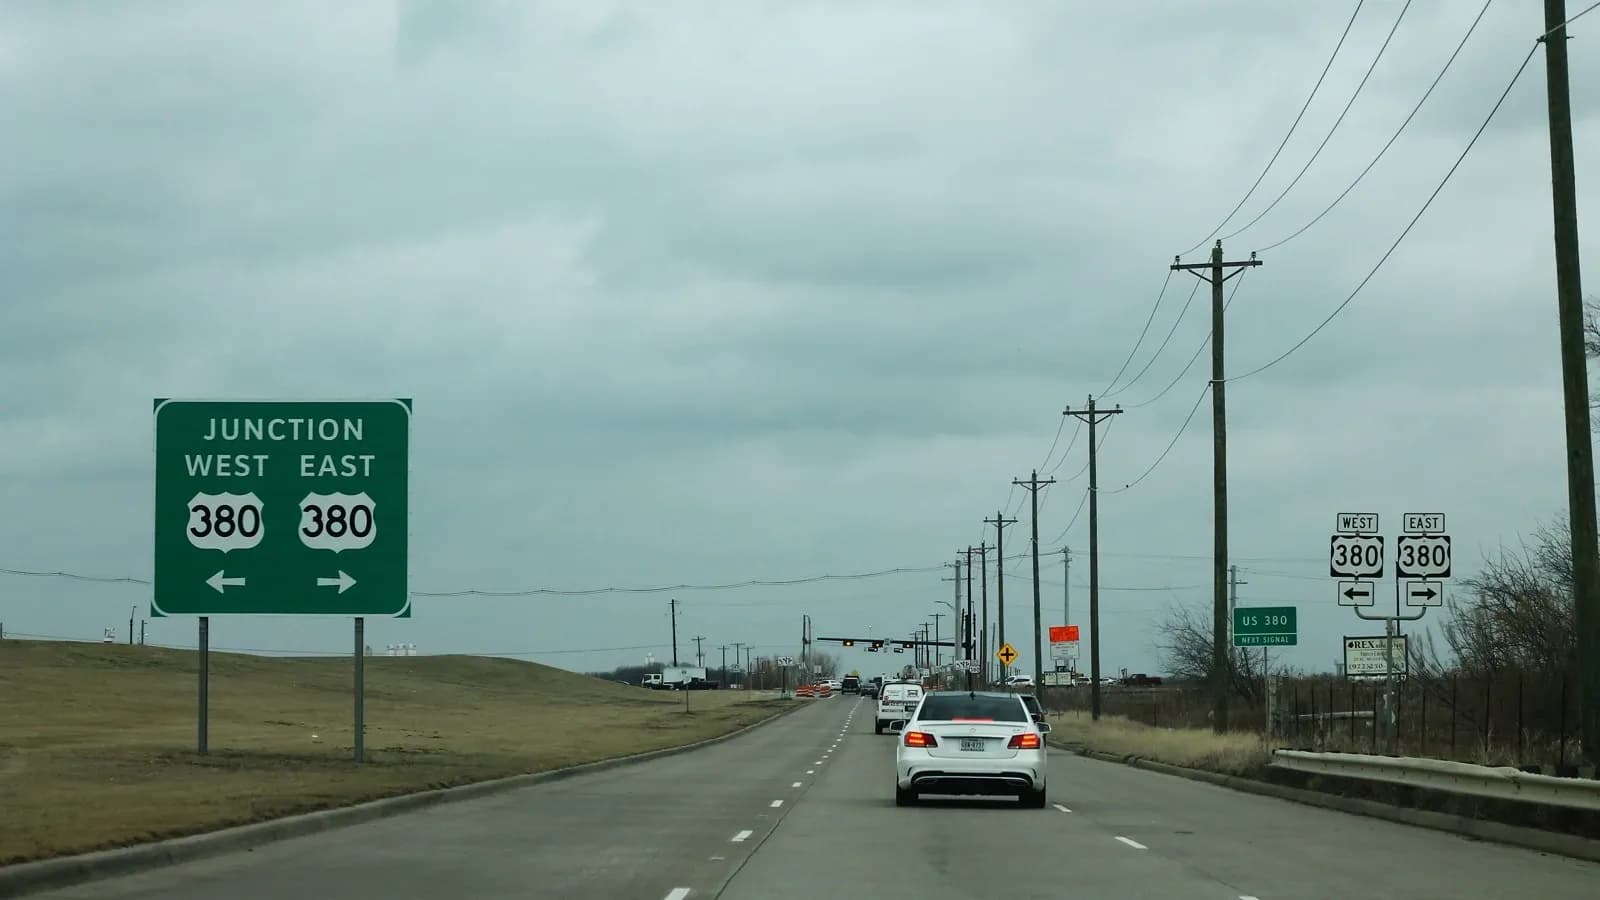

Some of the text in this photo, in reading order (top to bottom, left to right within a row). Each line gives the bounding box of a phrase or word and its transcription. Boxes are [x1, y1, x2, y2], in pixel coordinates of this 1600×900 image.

[203, 418, 364, 441] JUNCTION
[185, 454, 376, 477] WEST EAST
[190, 504, 261, 538] 380
[302, 504, 373, 538] 380
[1342, 517, 1373, 529] WEST
[1409, 517, 1439, 529] EAST
[1335, 544, 1379, 567] 380
[1402, 544, 1446, 567] 380
[1242, 615, 1288, 626] US 380
[1241, 636, 1289, 644] NEXT SIGNAL
[1354, 640, 1375, 649] REX
